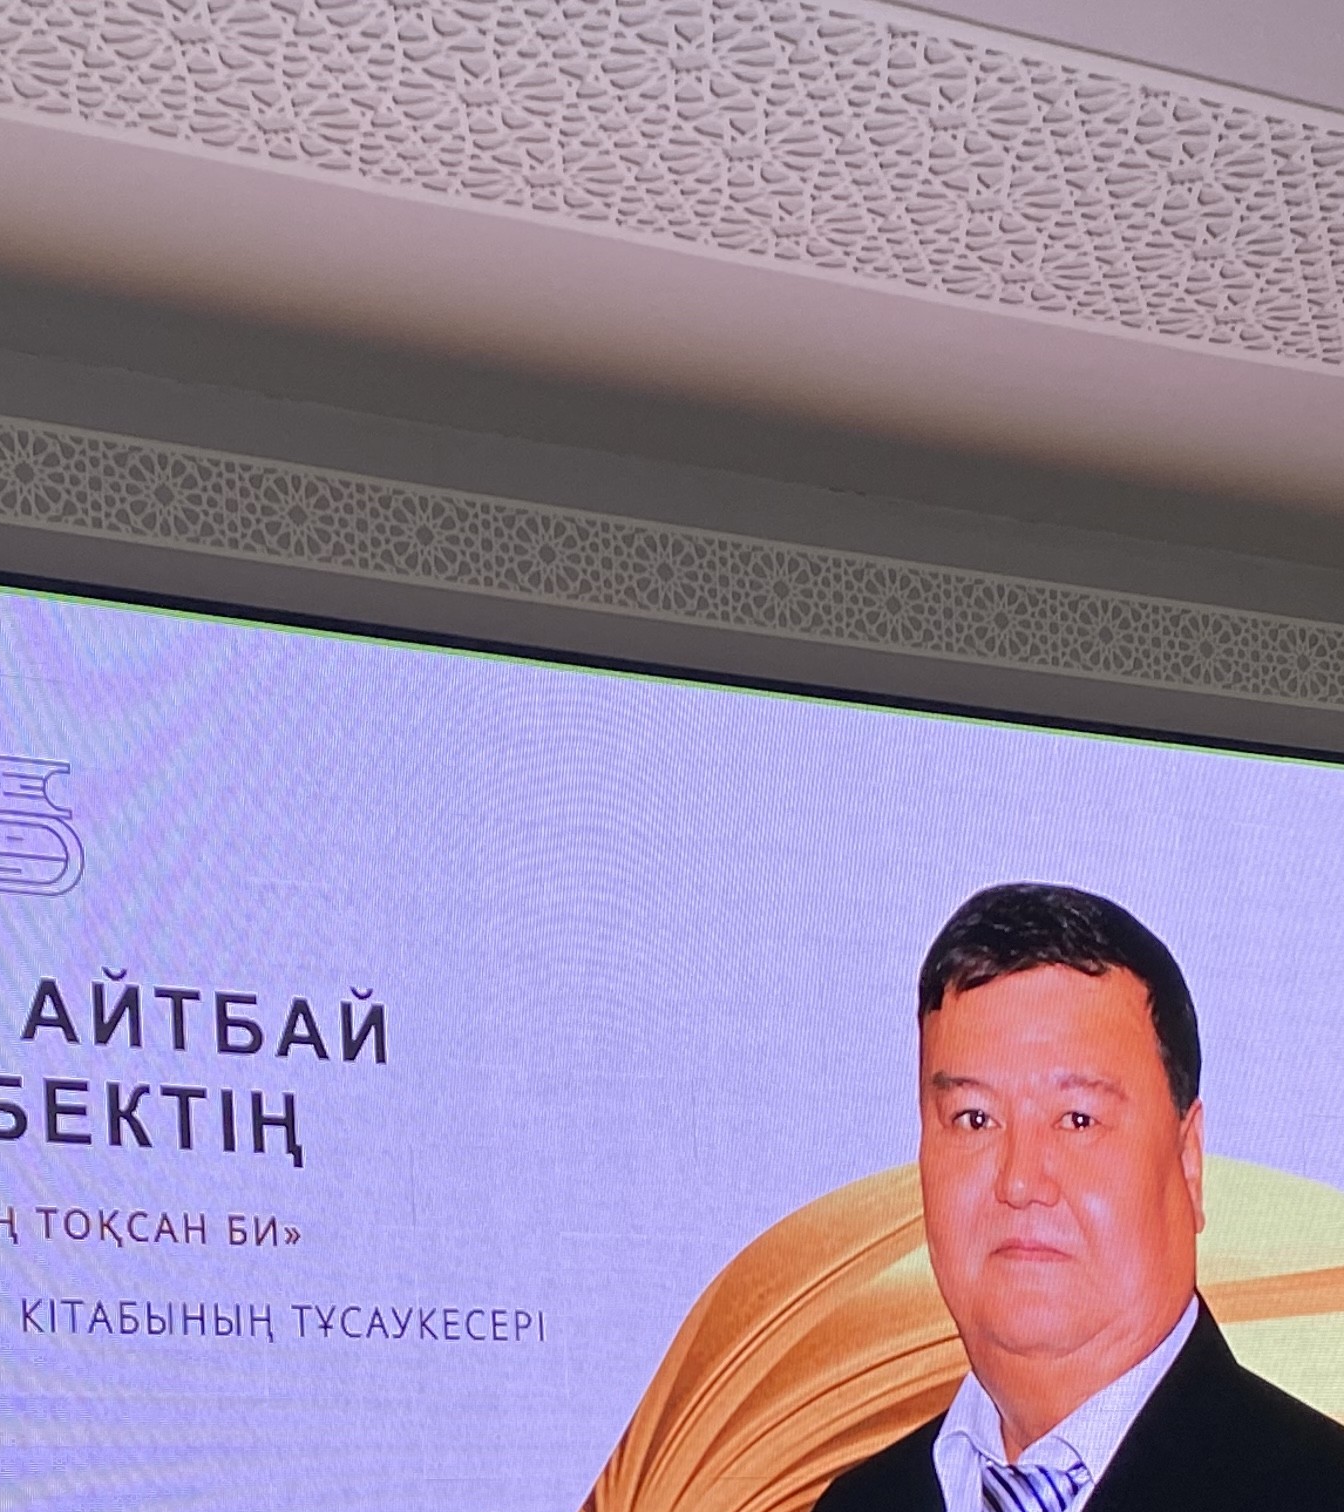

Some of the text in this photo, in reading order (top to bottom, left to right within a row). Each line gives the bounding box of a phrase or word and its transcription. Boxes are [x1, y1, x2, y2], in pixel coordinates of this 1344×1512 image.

[20, 966, 387, 1064] АЙТБАЙ
[36, 1206, 206, 1247] ТОҚСАН
[228, 1212, 301, 1247] БИ»
[22, 1297, 274, 1343] КІТАБЫНЫҢ
[291, 1304, 545, 1342] ТҰСАУКЕСЕРІ
